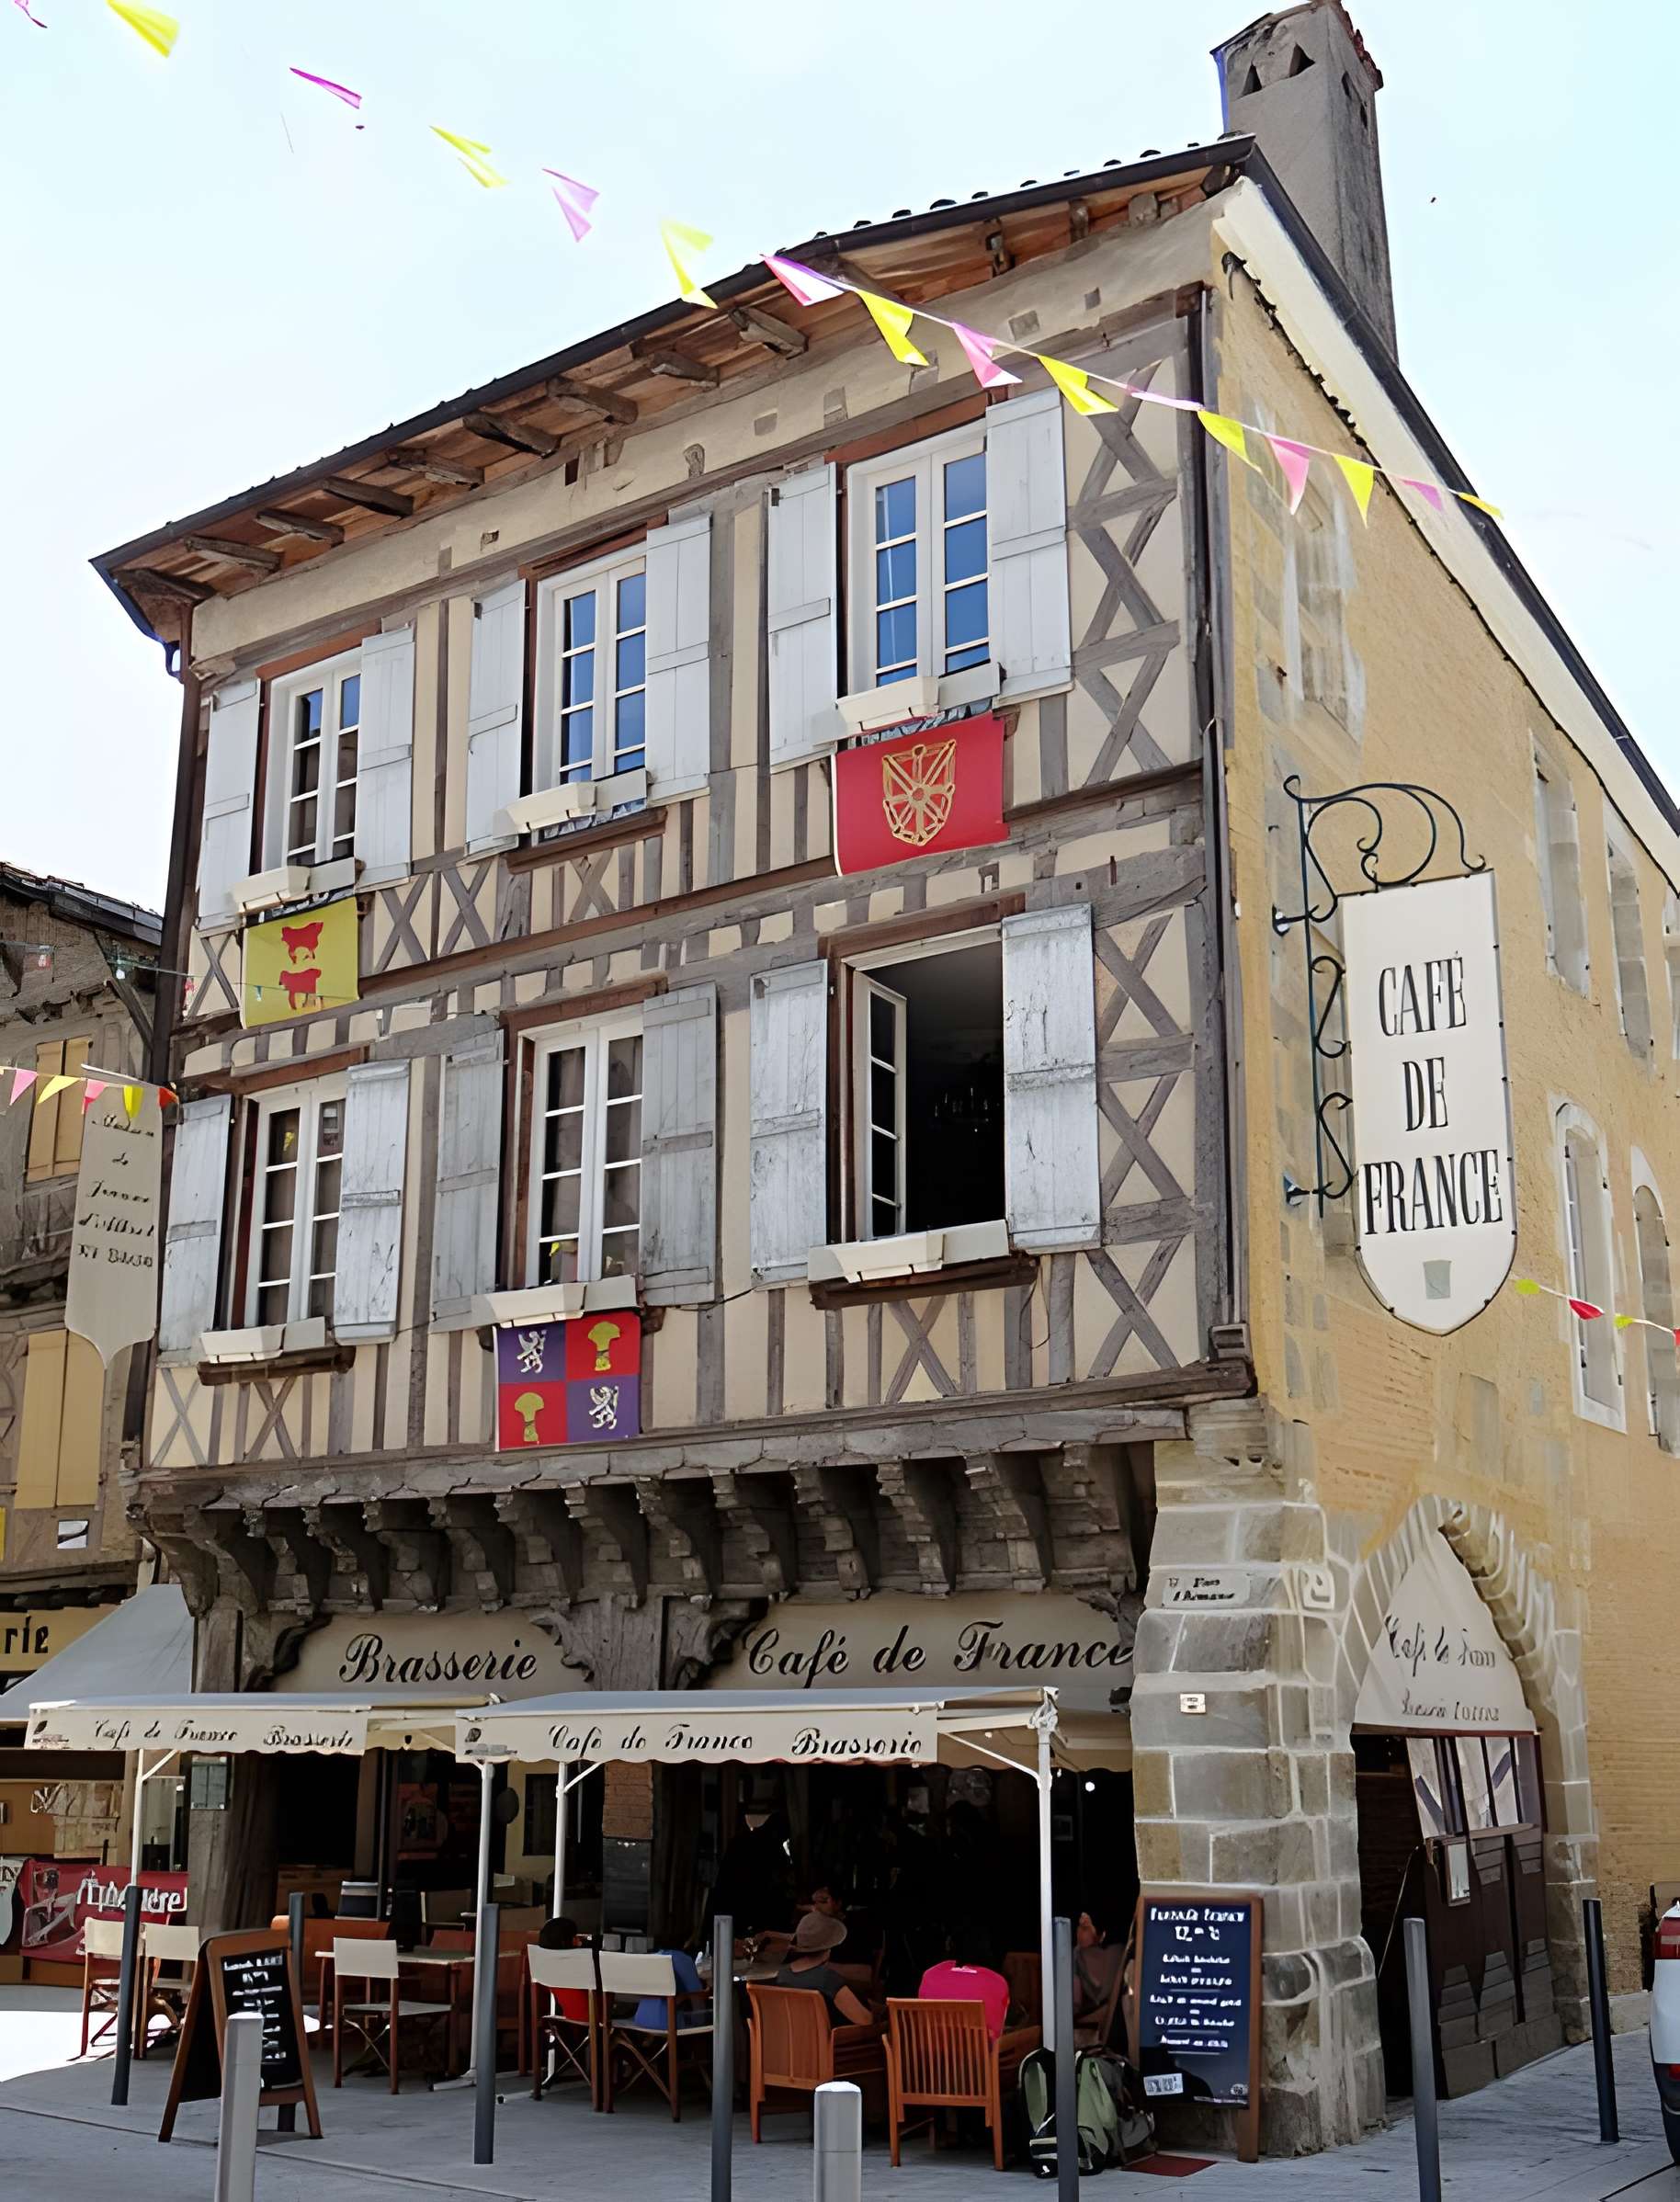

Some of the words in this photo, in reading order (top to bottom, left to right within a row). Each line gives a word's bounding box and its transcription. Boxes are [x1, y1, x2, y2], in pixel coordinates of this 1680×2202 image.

[1402, 1057, 1449, 1132] DE
[1363, 1149, 1504, 1235] FRANCE
[338, 1632, 539, 1684] Brasserie
[745, 1627, 849, 1689] Café
[873, 1624, 926, 1674] de
[953, 1620, 1134, 1672] France
